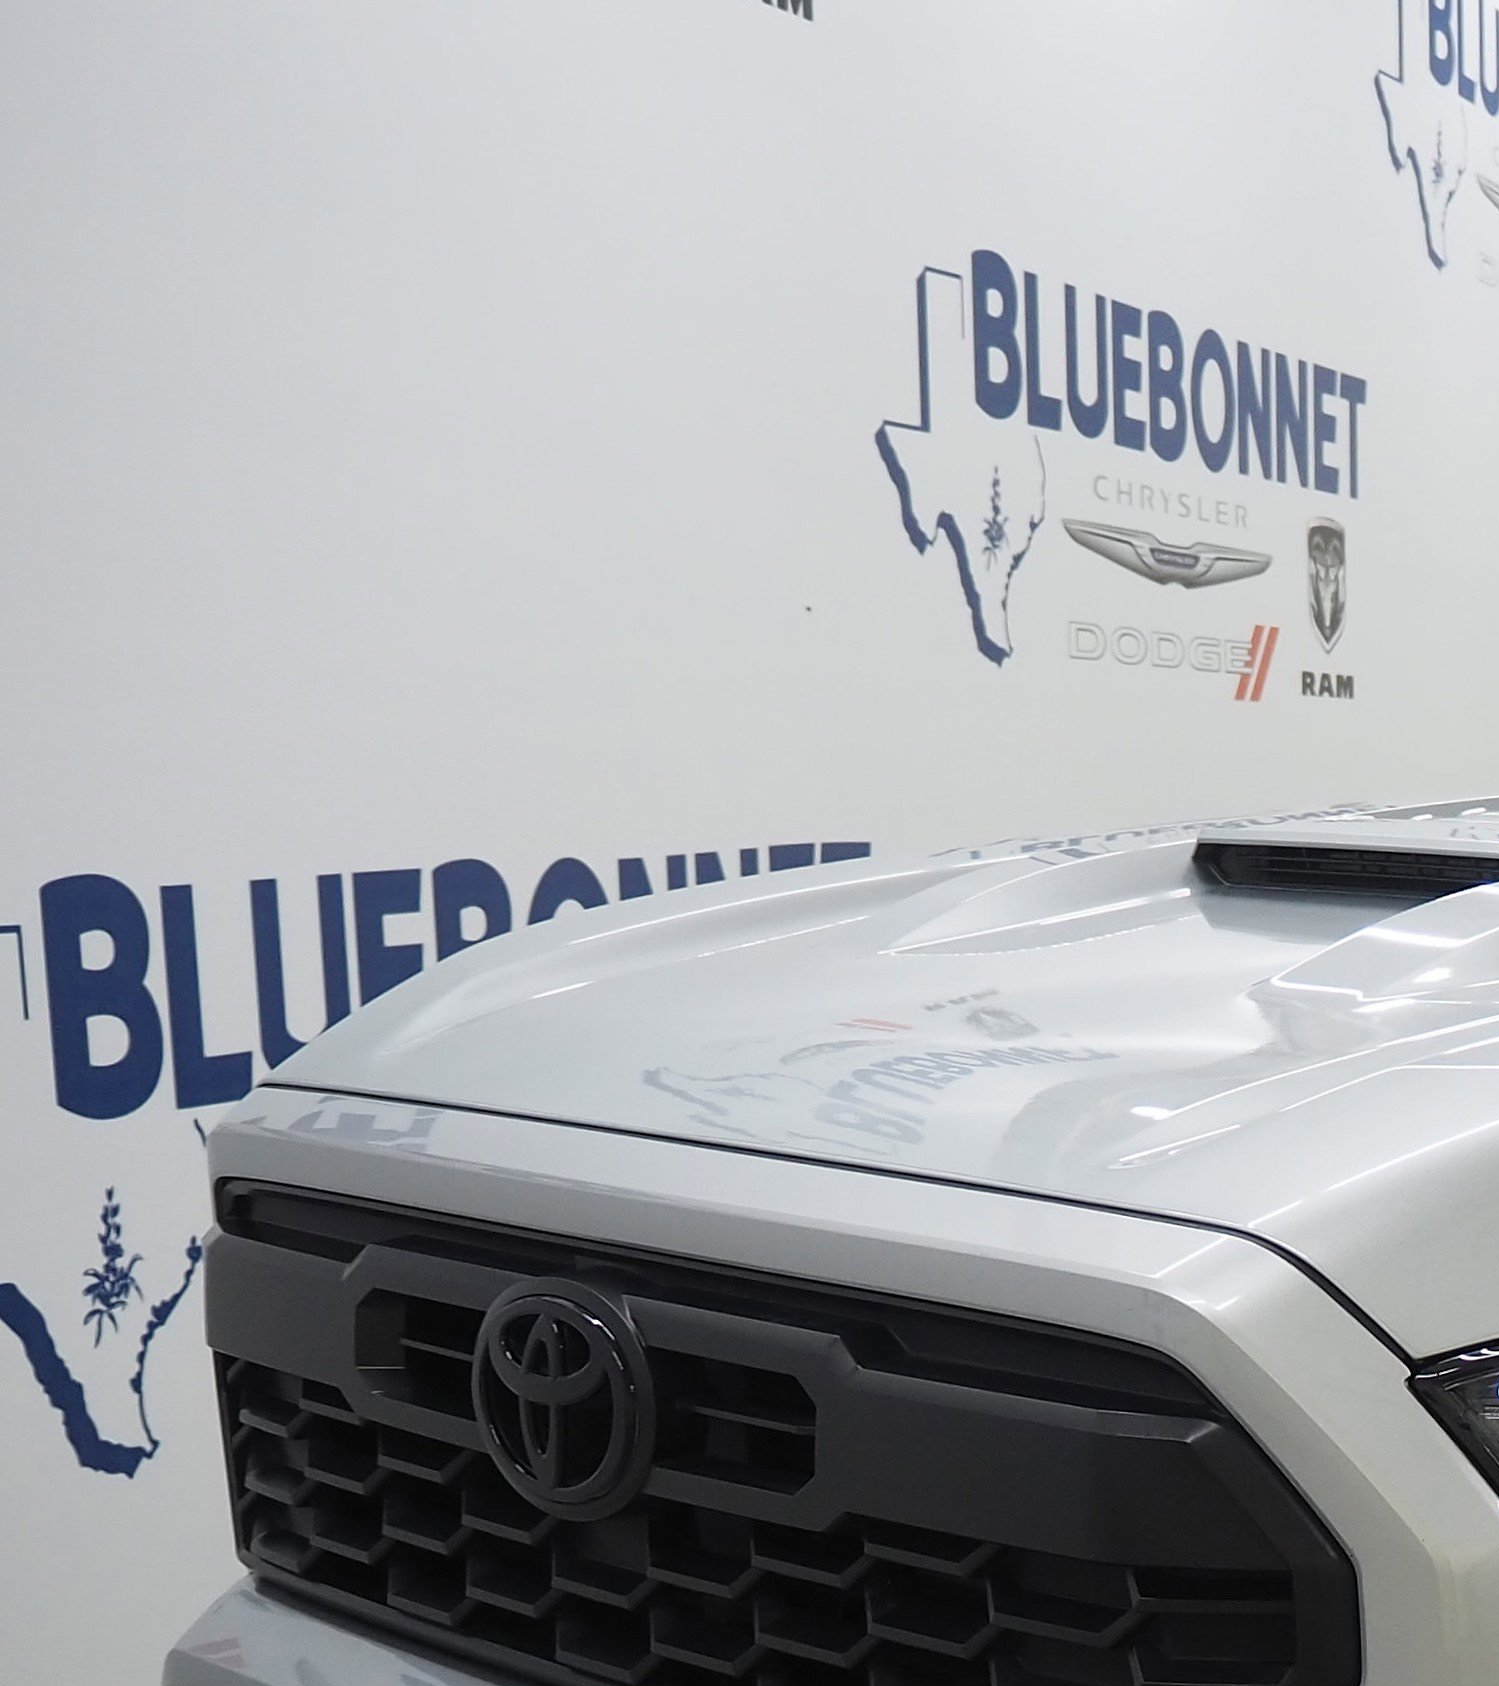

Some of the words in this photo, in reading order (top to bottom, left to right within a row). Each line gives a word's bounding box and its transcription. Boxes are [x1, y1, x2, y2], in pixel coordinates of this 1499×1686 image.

[971, 249, 1368, 499] BLUEBONNET
[1092, 474, 1249, 529] CHRYSLER
[1068, 621, 1254, 675] DODGE
[1301, 671, 1355, 699] RAM
